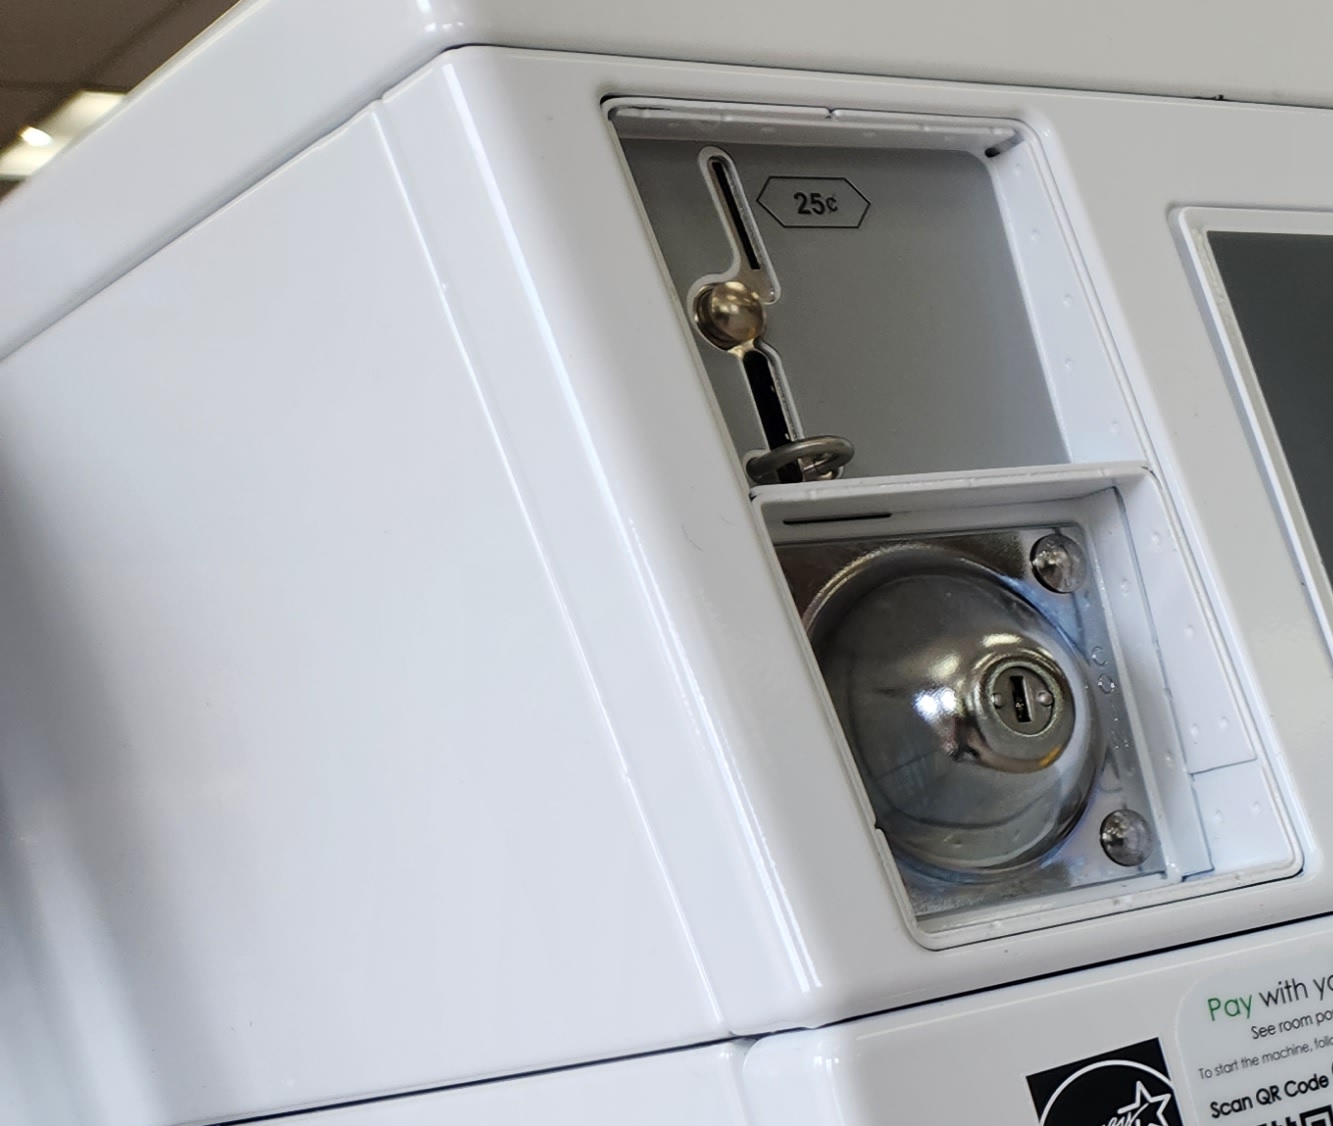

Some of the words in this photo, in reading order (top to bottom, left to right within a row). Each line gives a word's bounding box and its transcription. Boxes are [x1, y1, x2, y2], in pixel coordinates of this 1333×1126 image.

[793, 191, 838, 215] 25¢
[1207, 993, 1253, 1022] Pay
[1258, 977, 1309, 1008] with
[1250, 1023, 1277, 1040] See
[1278, 1014, 1314, 1033] room
[1198, 1067, 1212, 1080] To
[1214, 1060, 1239, 1077] start
[1240, 1055, 1260, 1070] the
[1261, 1043, 1314, 1065] machine,
[1210, 1095, 1254, 1119] Scan
[1255, 1084, 1282, 1106] QR
[1283, 1073, 1330, 1098] Code
